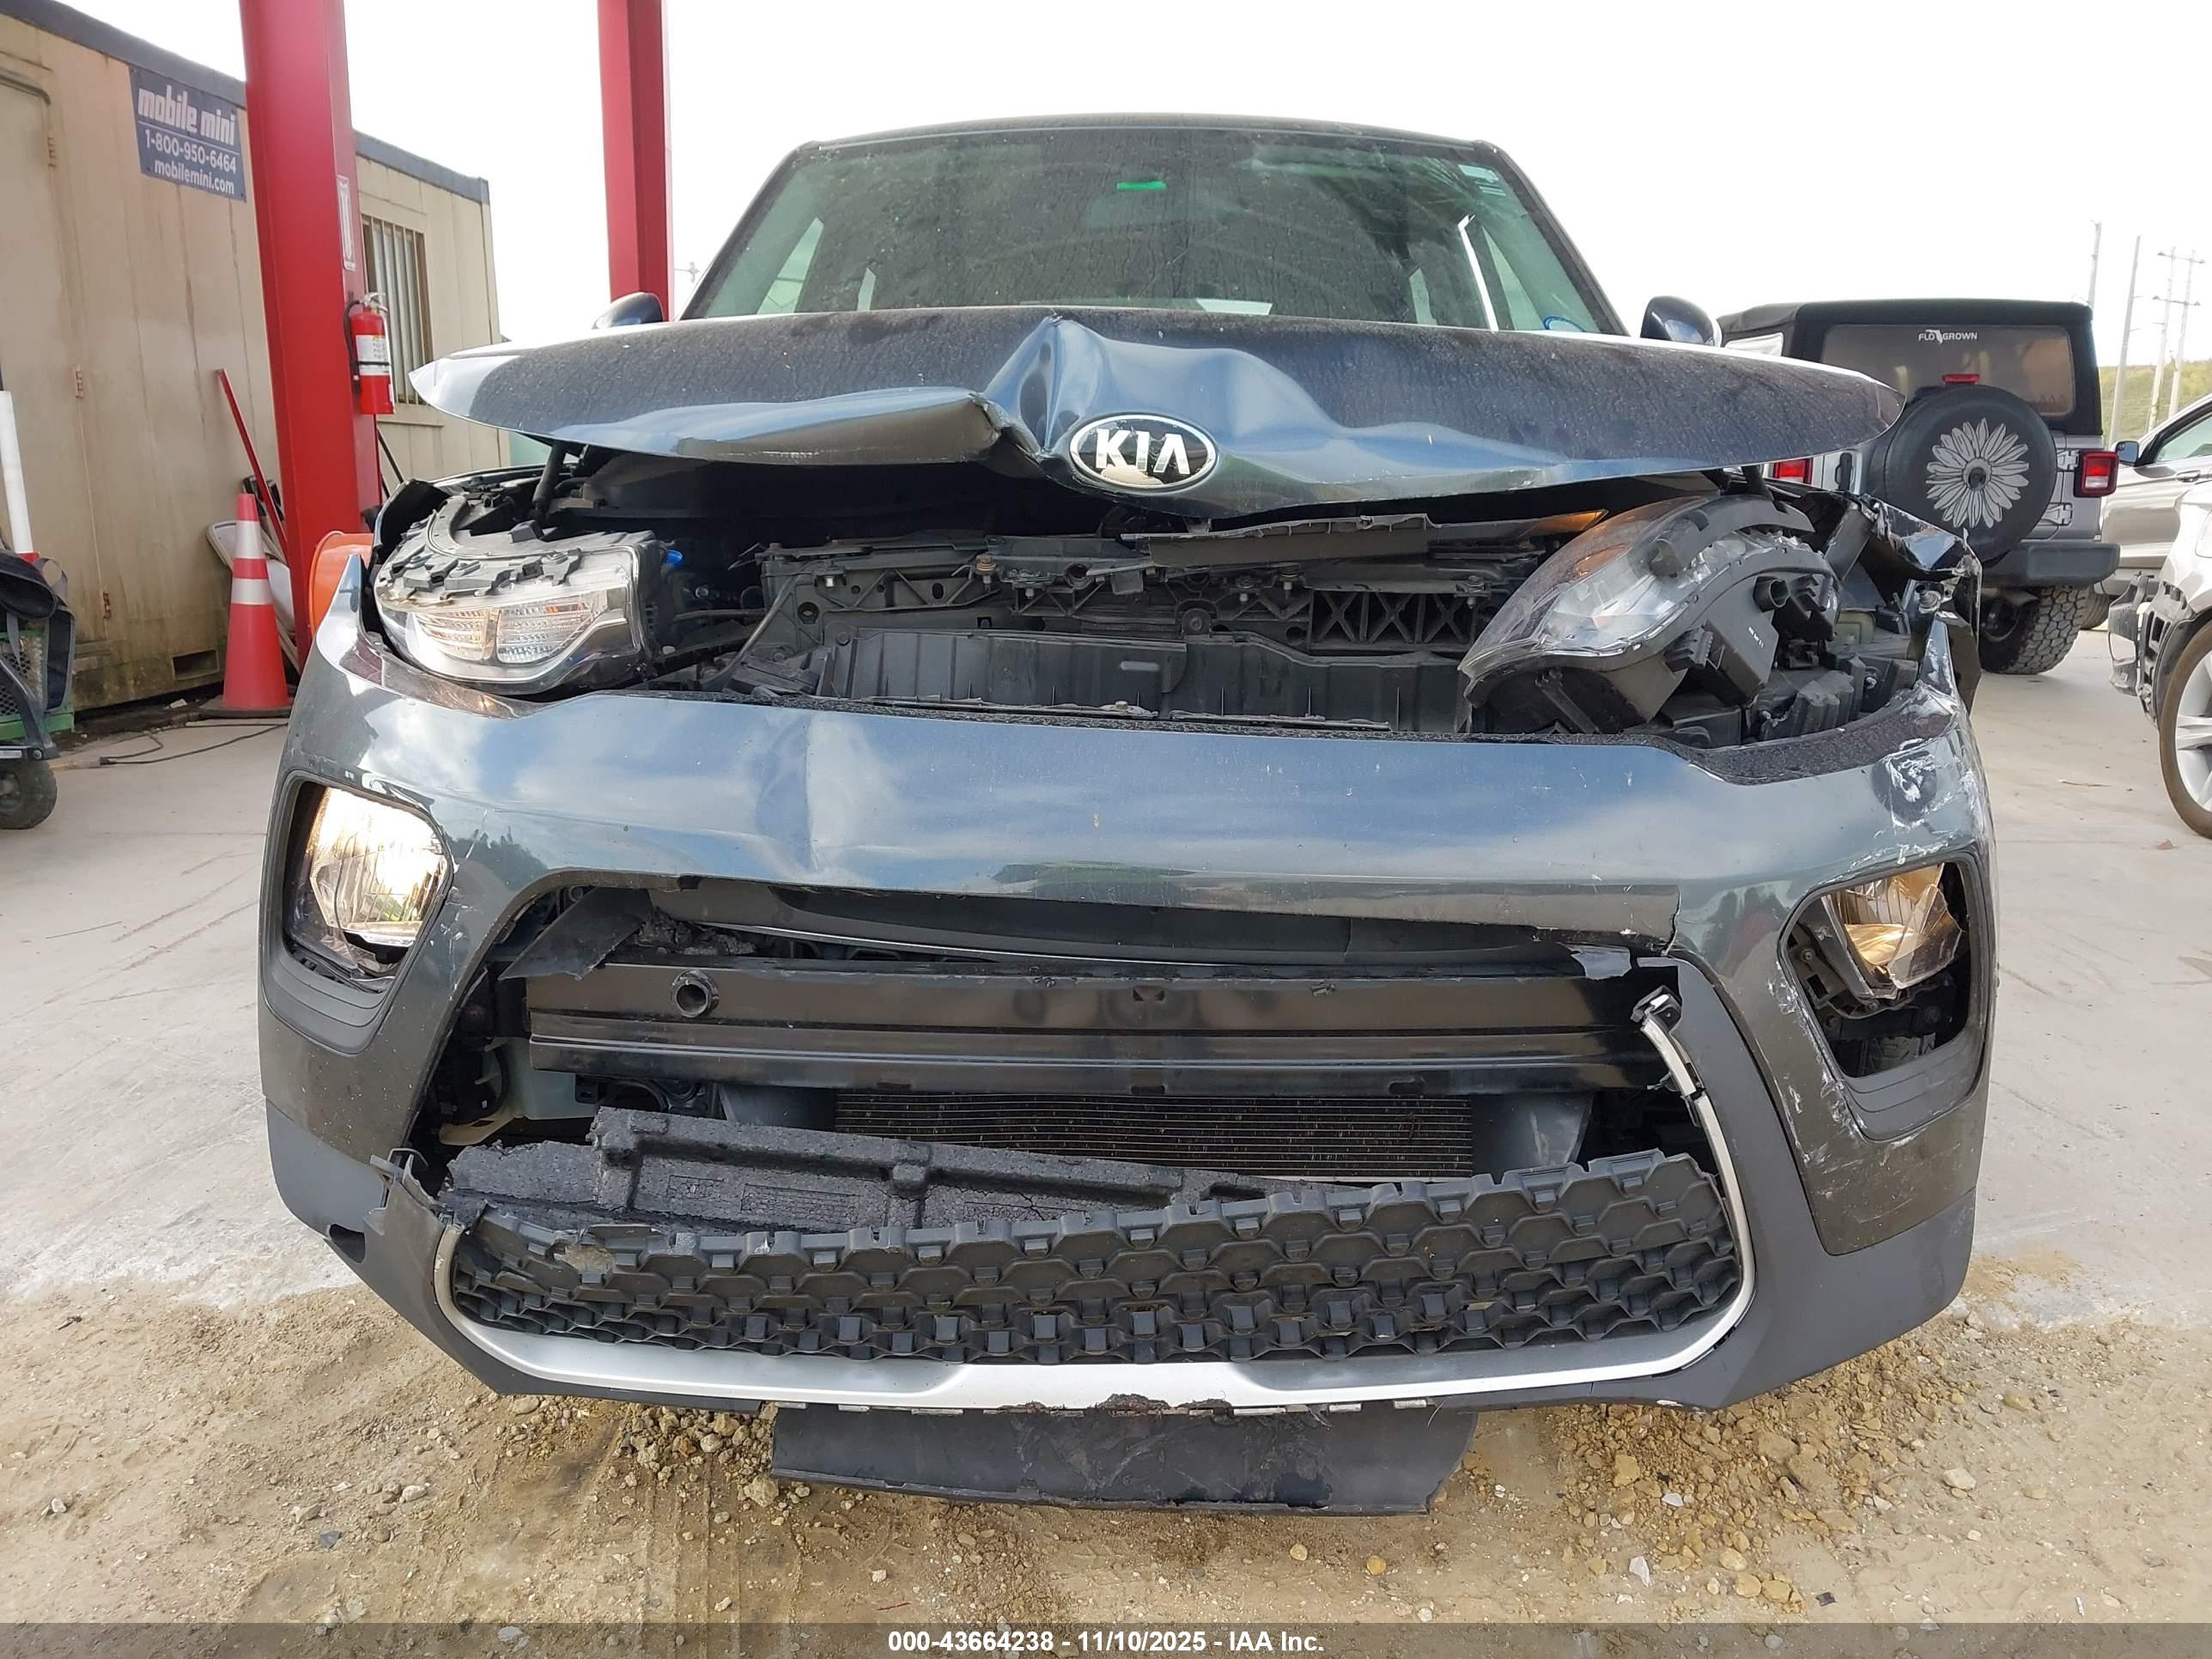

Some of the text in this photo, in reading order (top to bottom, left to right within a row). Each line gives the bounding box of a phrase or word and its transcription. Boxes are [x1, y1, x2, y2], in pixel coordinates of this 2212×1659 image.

[138, 85, 234, 146] mobile mini
[145, 130, 236, 173] 1-800-950-6464
[155, 160, 234, 194] mobilemini.com
[1096, 428, 1190, 474] KIA
